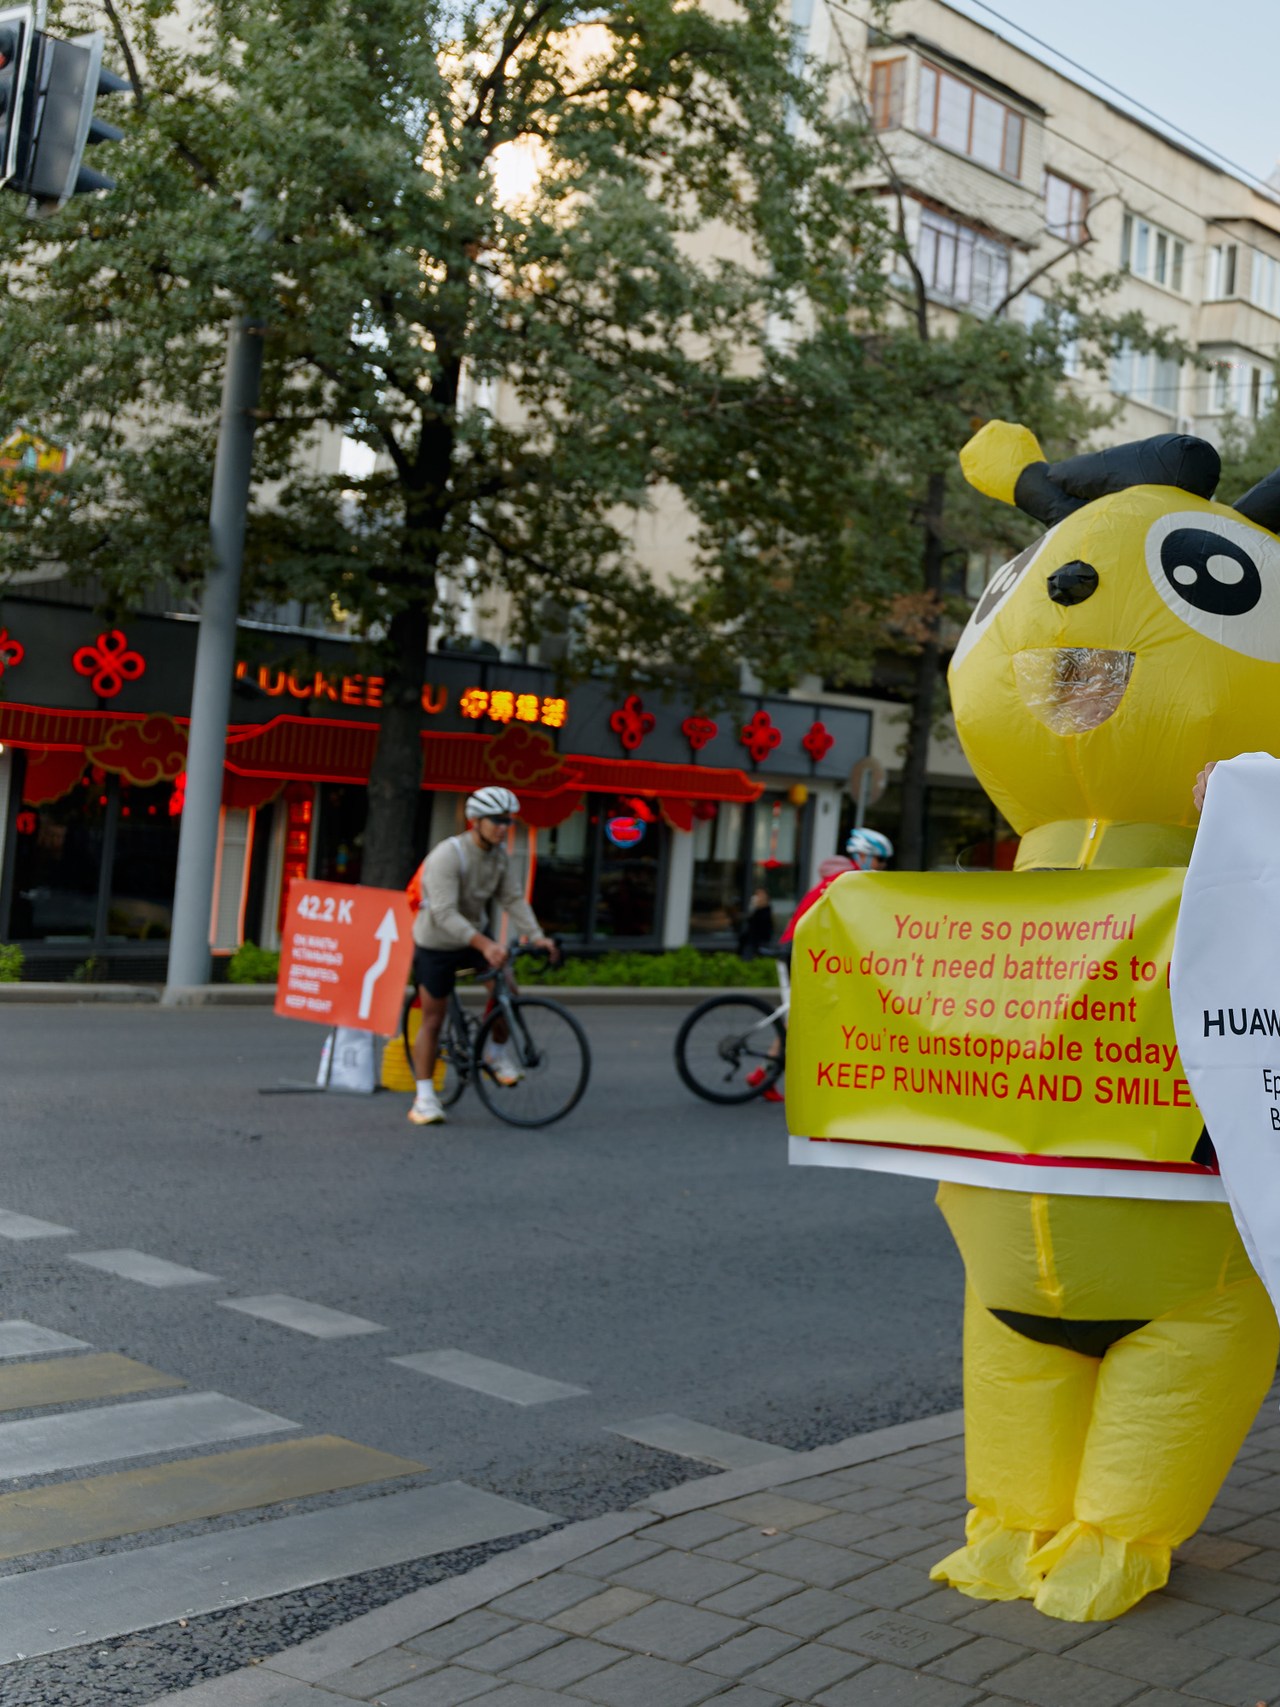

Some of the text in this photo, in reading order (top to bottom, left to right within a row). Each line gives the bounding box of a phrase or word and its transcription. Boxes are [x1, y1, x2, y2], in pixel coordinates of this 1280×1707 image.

[236, 661, 384, 708] UCKEE
[296, 894, 336, 922] 42.2
[895, 913, 1137, 947] You're so powerful
[807, 947, 853, 975] You
[859, 951, 925, 977] don't
[931, 953, 996, 980] need
[1003, 953, 1119, 982] batteries
[1129, 955, 1158, 983] to
[876, 988, 1137, 1023] You're so confident
[840, 1024, 1179, 1073] You're unstoppable today
[816, 1061, 1199, 1109] KEEP RUNNING AND SMILE
